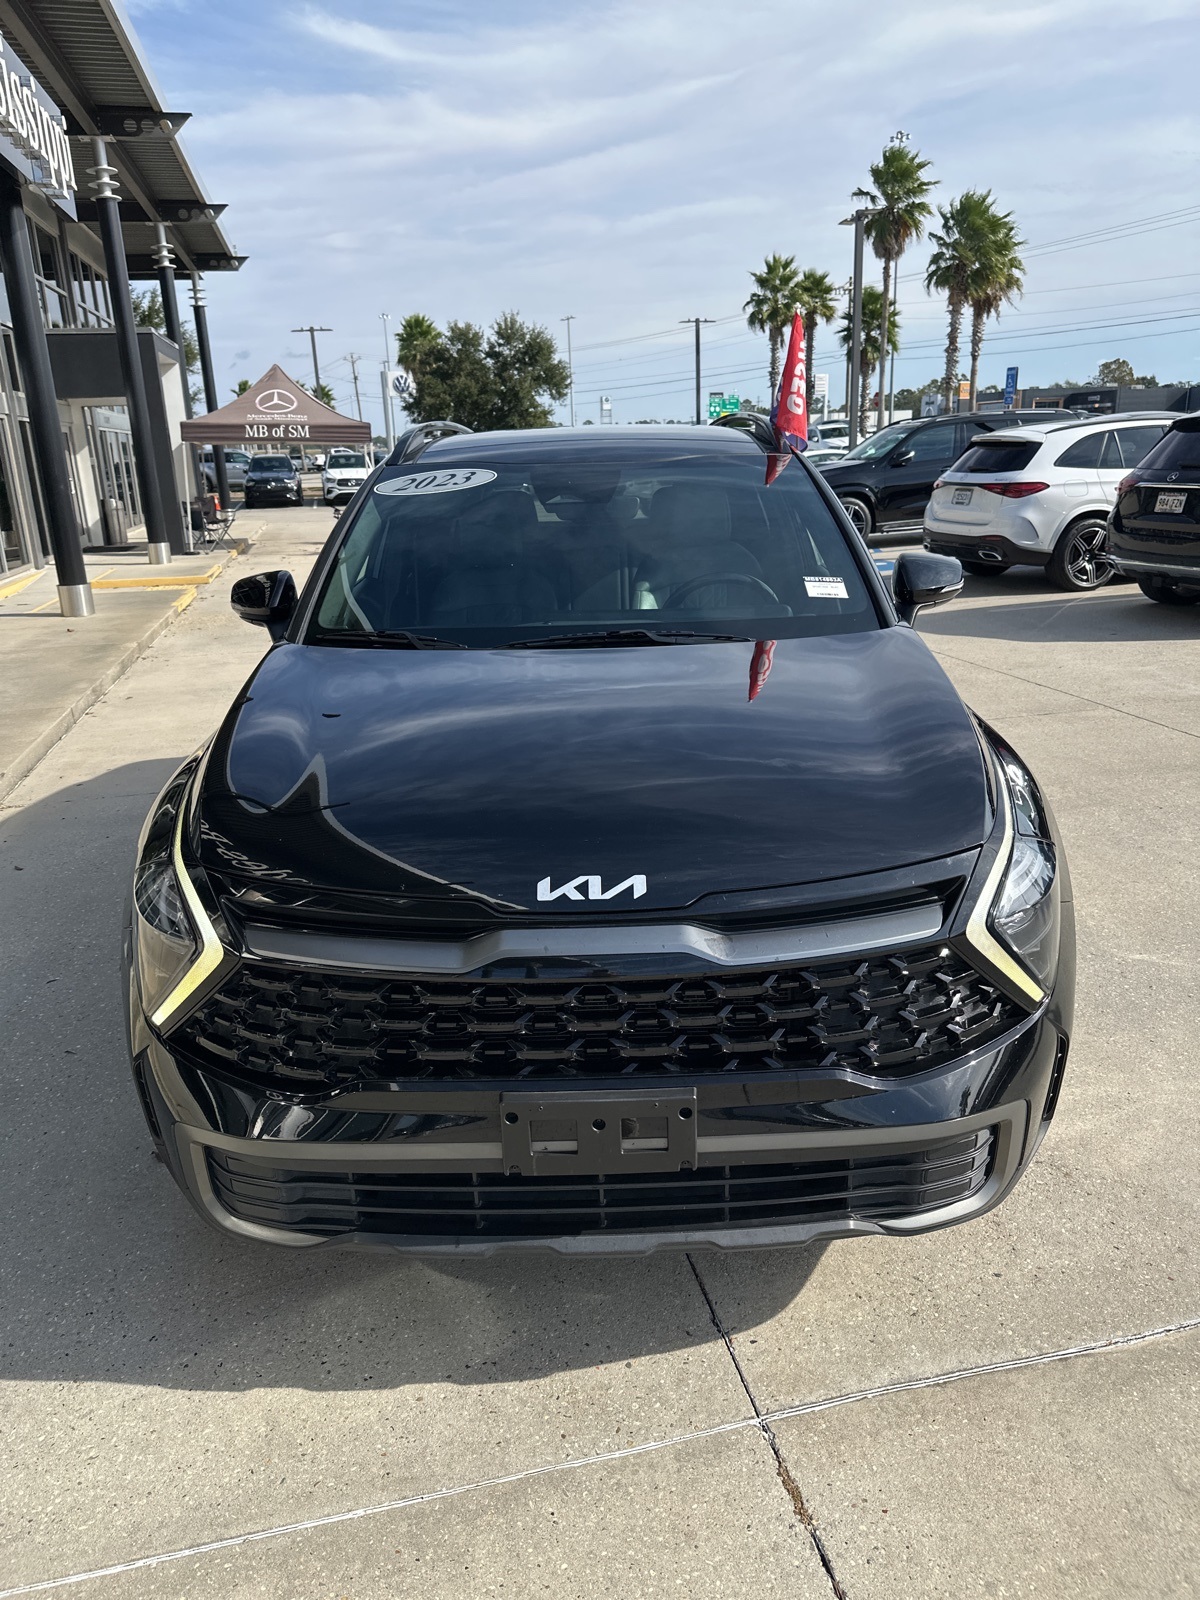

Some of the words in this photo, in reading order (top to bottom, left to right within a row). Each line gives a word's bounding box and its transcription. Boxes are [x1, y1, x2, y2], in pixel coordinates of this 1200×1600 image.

[245, 424, 269, 438] MB
[272, 424, 286, 438] of
[288, 424, 311, 438] SM
[392, 471, 477, 493] 2023
[537, 874, 647, 901] KIA
